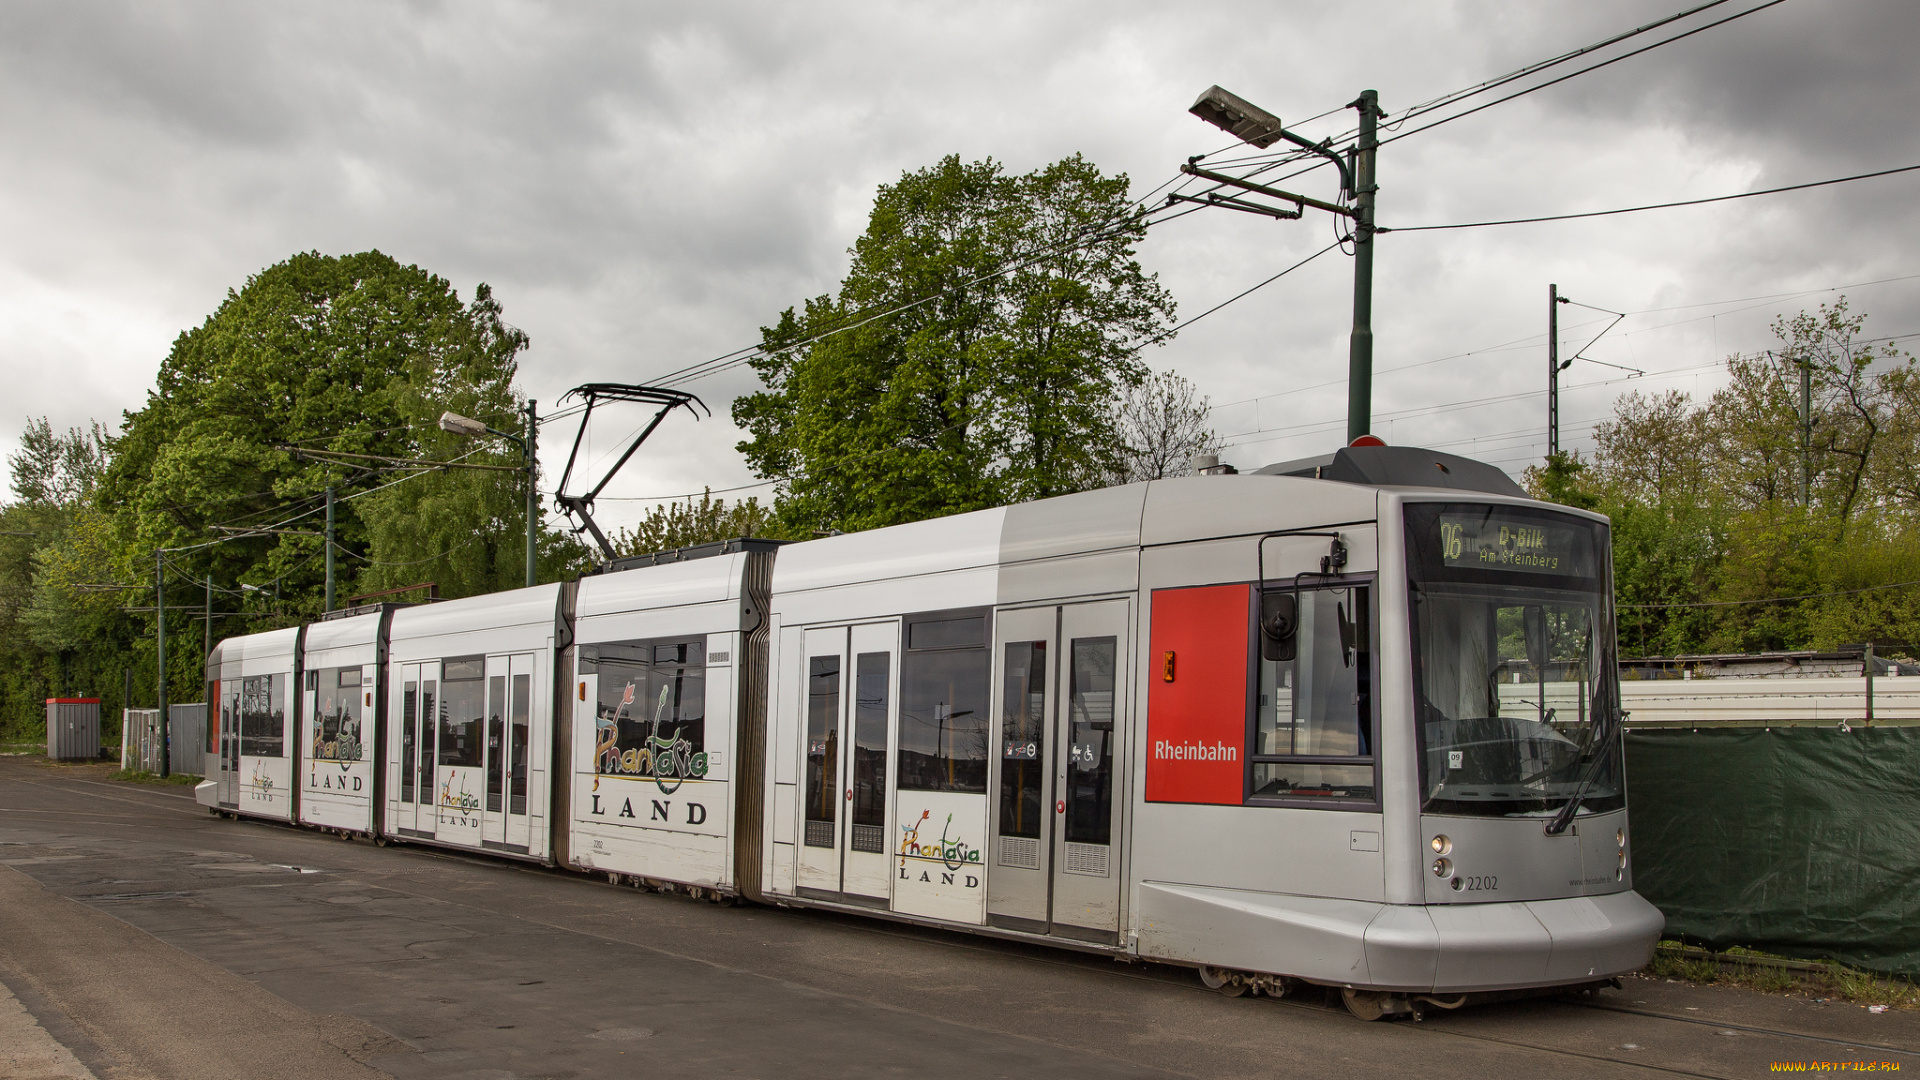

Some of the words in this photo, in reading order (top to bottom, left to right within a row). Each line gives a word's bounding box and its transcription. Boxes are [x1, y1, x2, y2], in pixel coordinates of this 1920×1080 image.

[1499, 526, 1545, 549] D-Bilk
[1480, 548, 1496, 562] Am
[1502, 550, 1558, 569] Steinberg
[592, 681, 709, 796] Phantasia
[1155, 739, 1237, 761] Rheinbahn
[1450, 753, 1461, 761] 09
[311, 773, 362, 791] LAND
[252, 792, 273, 802] LAND
[592, 794, 707, 825] LAND
[440, 814, 479, 828] LAND
[900, 808, 980, 872] Phantasia
[899, 867, 980, 889] LAND
[1467, 875, 1498, 891] 2202
